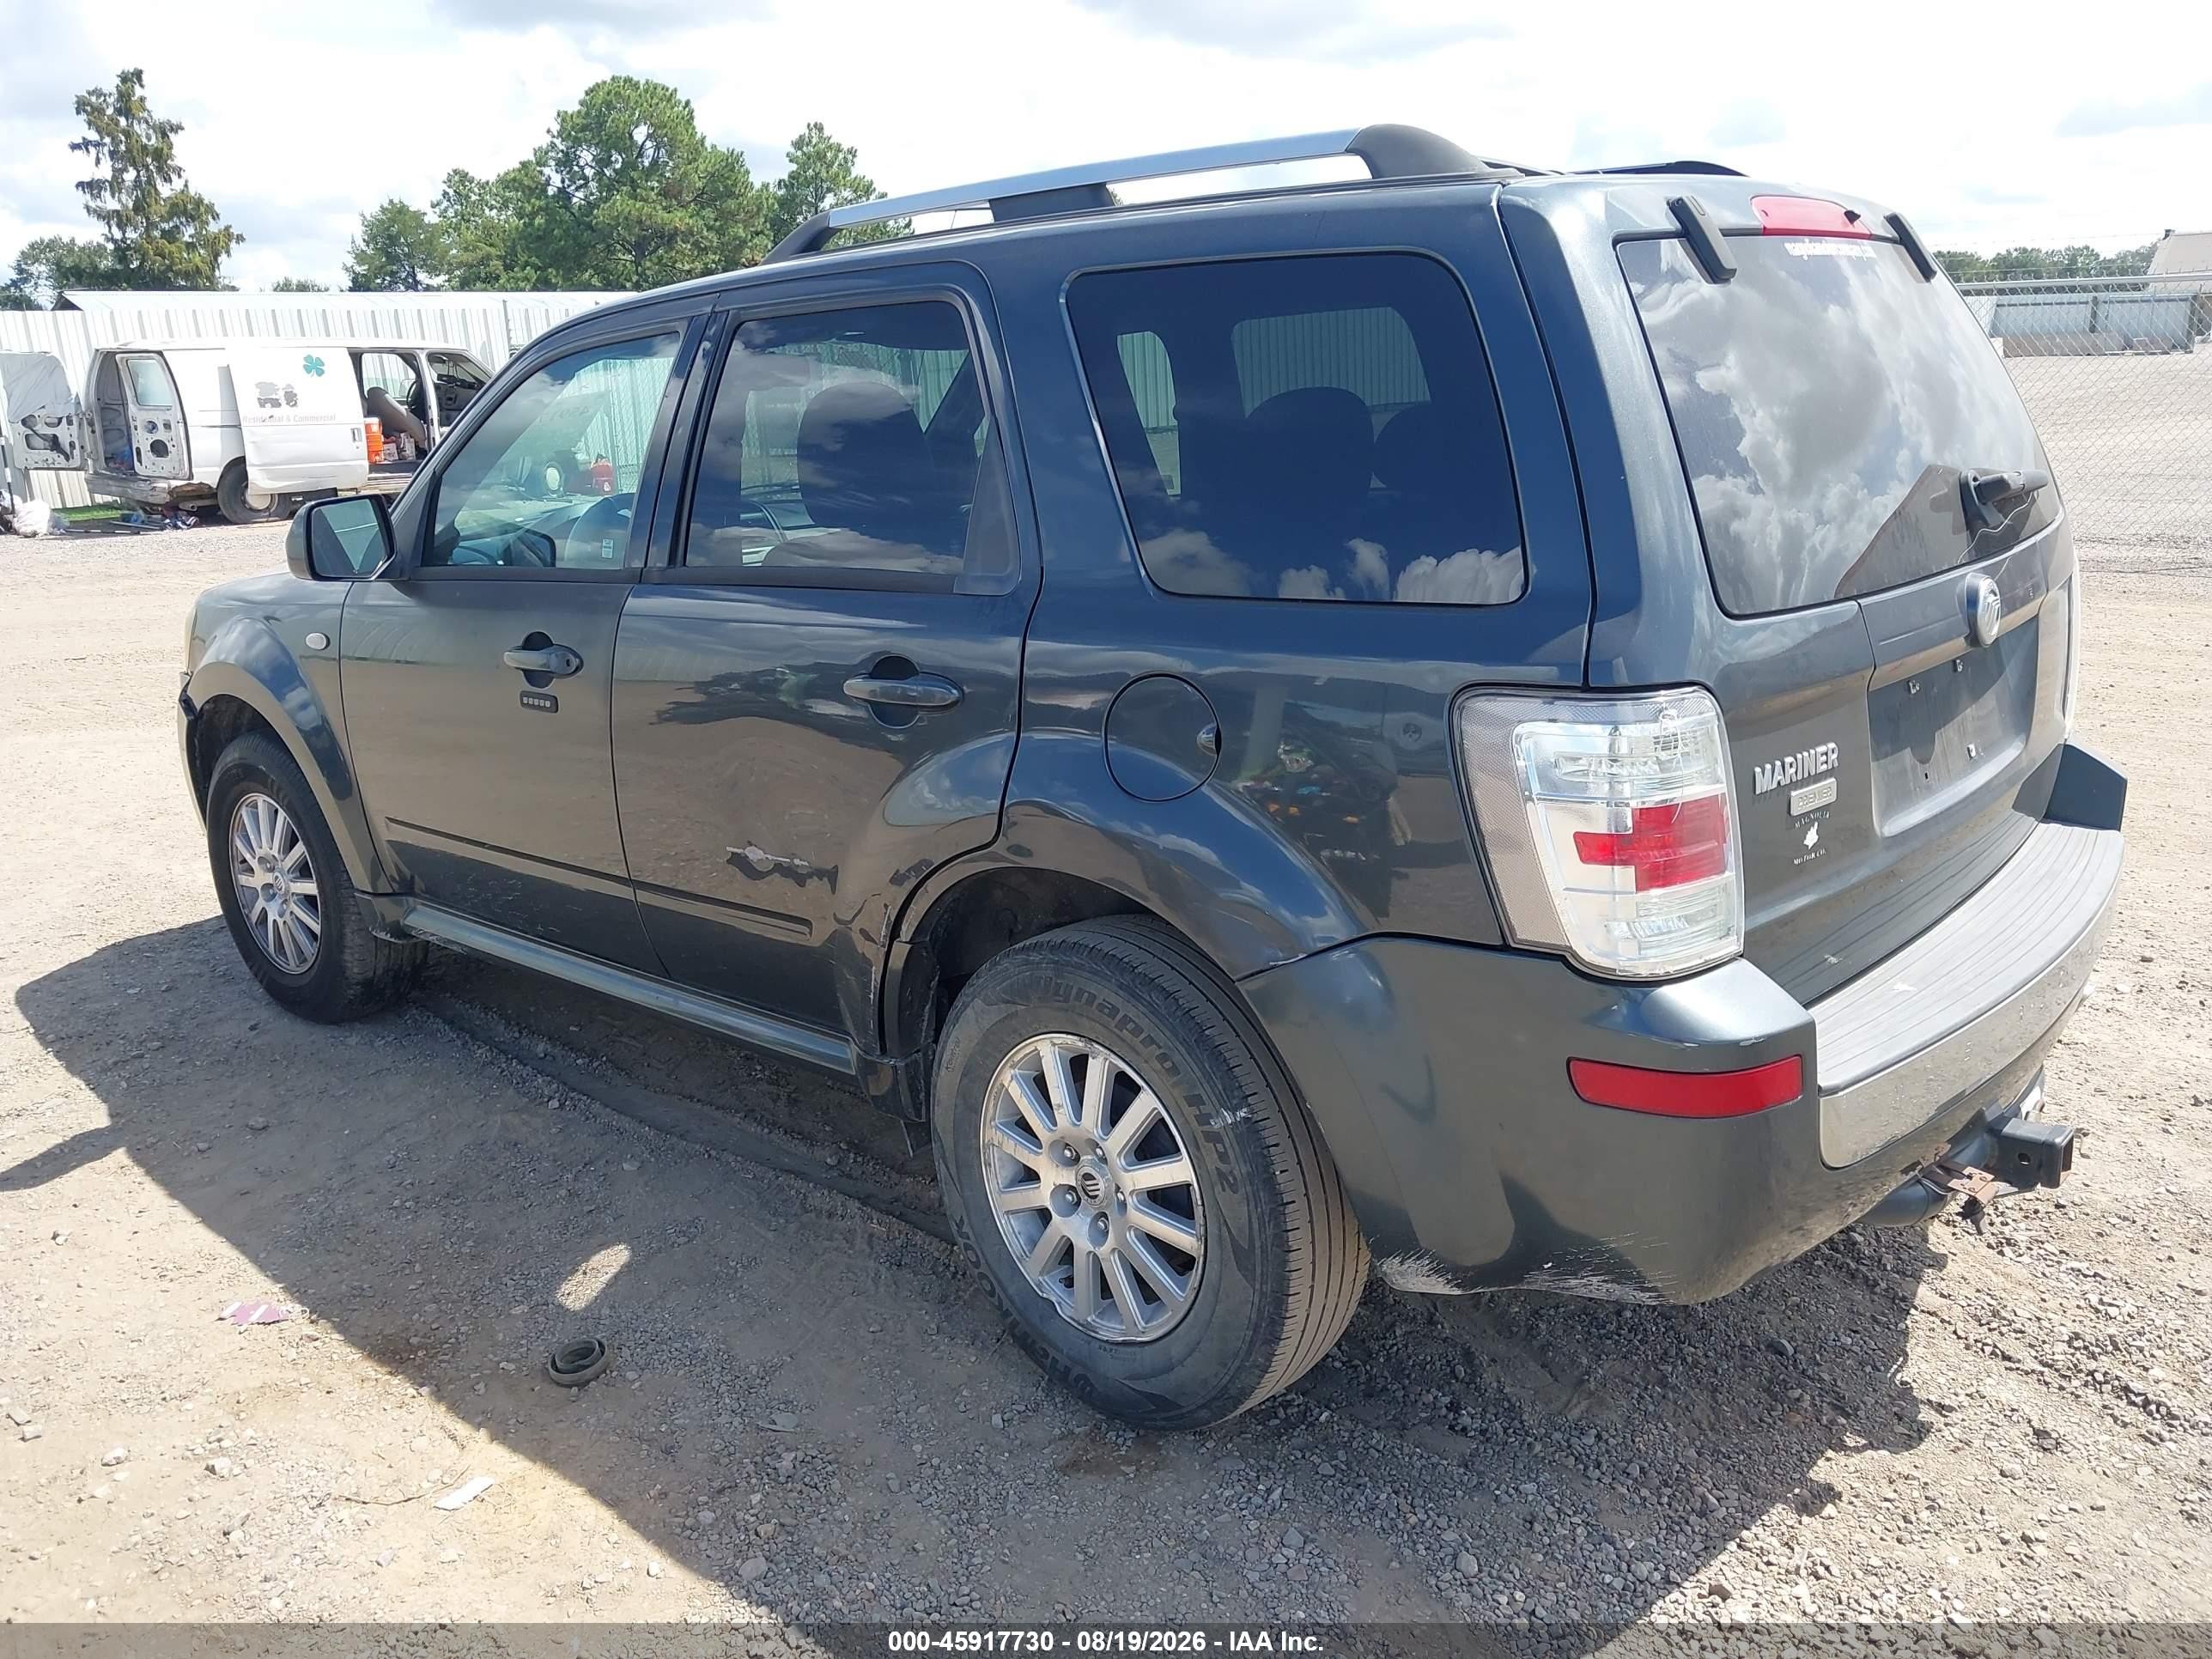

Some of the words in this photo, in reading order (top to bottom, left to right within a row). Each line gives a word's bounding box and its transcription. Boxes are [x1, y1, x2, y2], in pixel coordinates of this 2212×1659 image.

[294, 413, 336, 422] Commercial
[1753, 742, 1839, 795] MARINER
[1797, 786, 1832, 808] PREMIER
